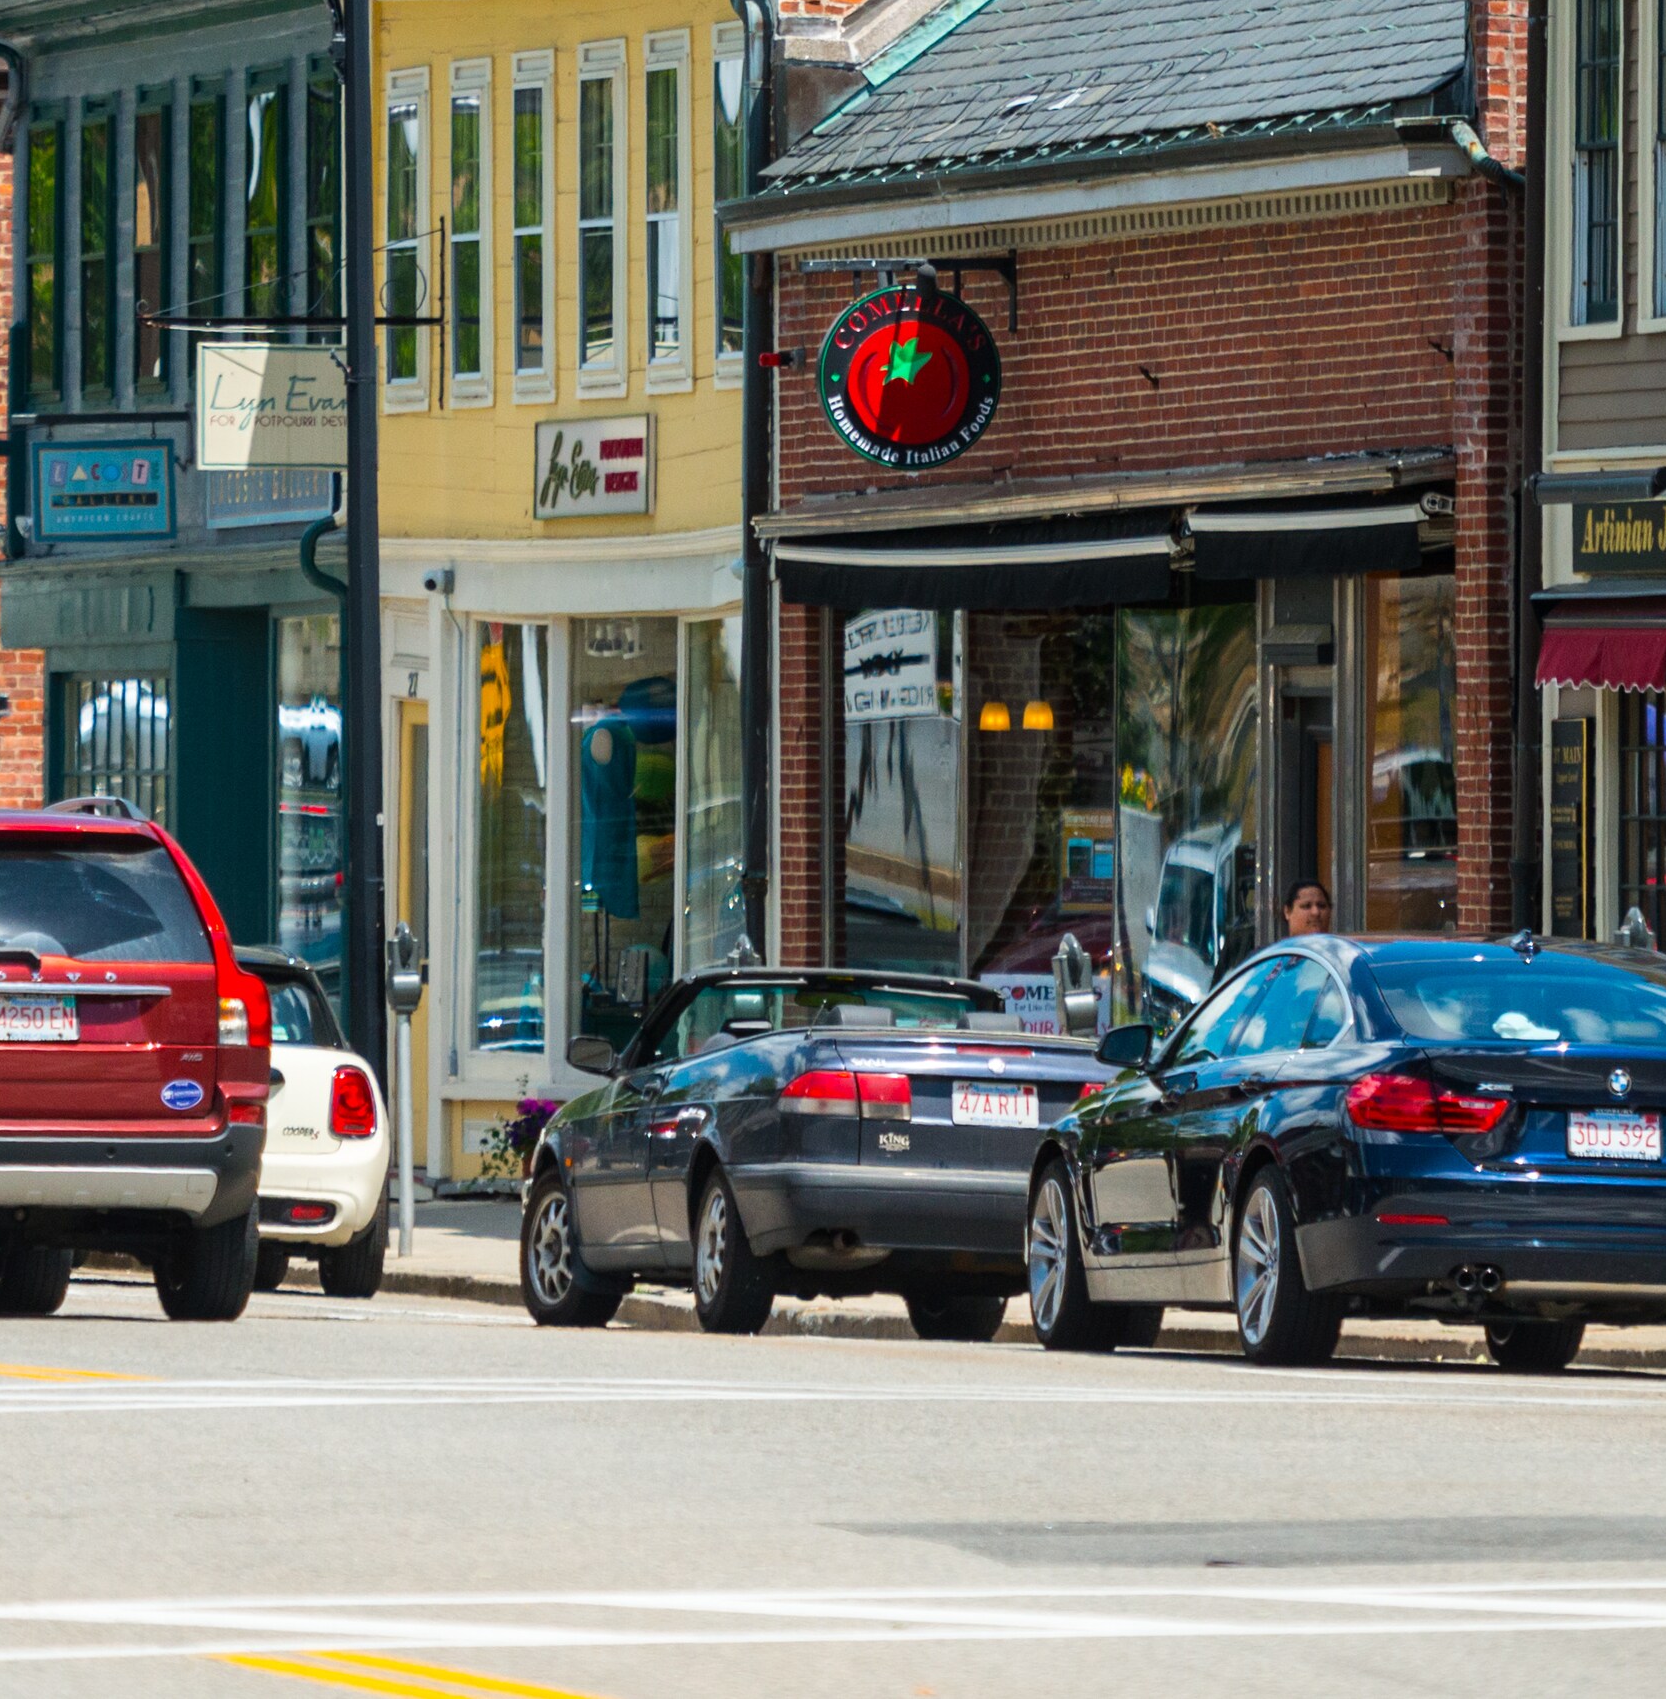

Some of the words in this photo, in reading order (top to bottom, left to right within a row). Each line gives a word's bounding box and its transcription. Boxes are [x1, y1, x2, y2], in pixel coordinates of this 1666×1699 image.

[835, 292, 985, 350] COMELLA'S
[210, 374, 275, 431] Lyn
[285, 375, 347, 412] Evan
[210, 415, 235, 427] FOR
[254, 414, 316, 427] POTPOURRI
[321, 415, 347, 427] DESI
[827, 394, 899, 463] Homemade
[906, 439, 960, 464] Italian
[960, 397, 994, 441] Foods
[1581, 507, 1653, 554] Artinian
[1001, 985, 1102, 1001] COMES
[50, 1008, 74, 1030] EN
[283, 1126, 314, 1136] COOPER
[879, 1132, 910, 1145] KING
[1574, 1122, 1611, 1146] 3DJ
[1619, 1123, 1657, 1148] 392
